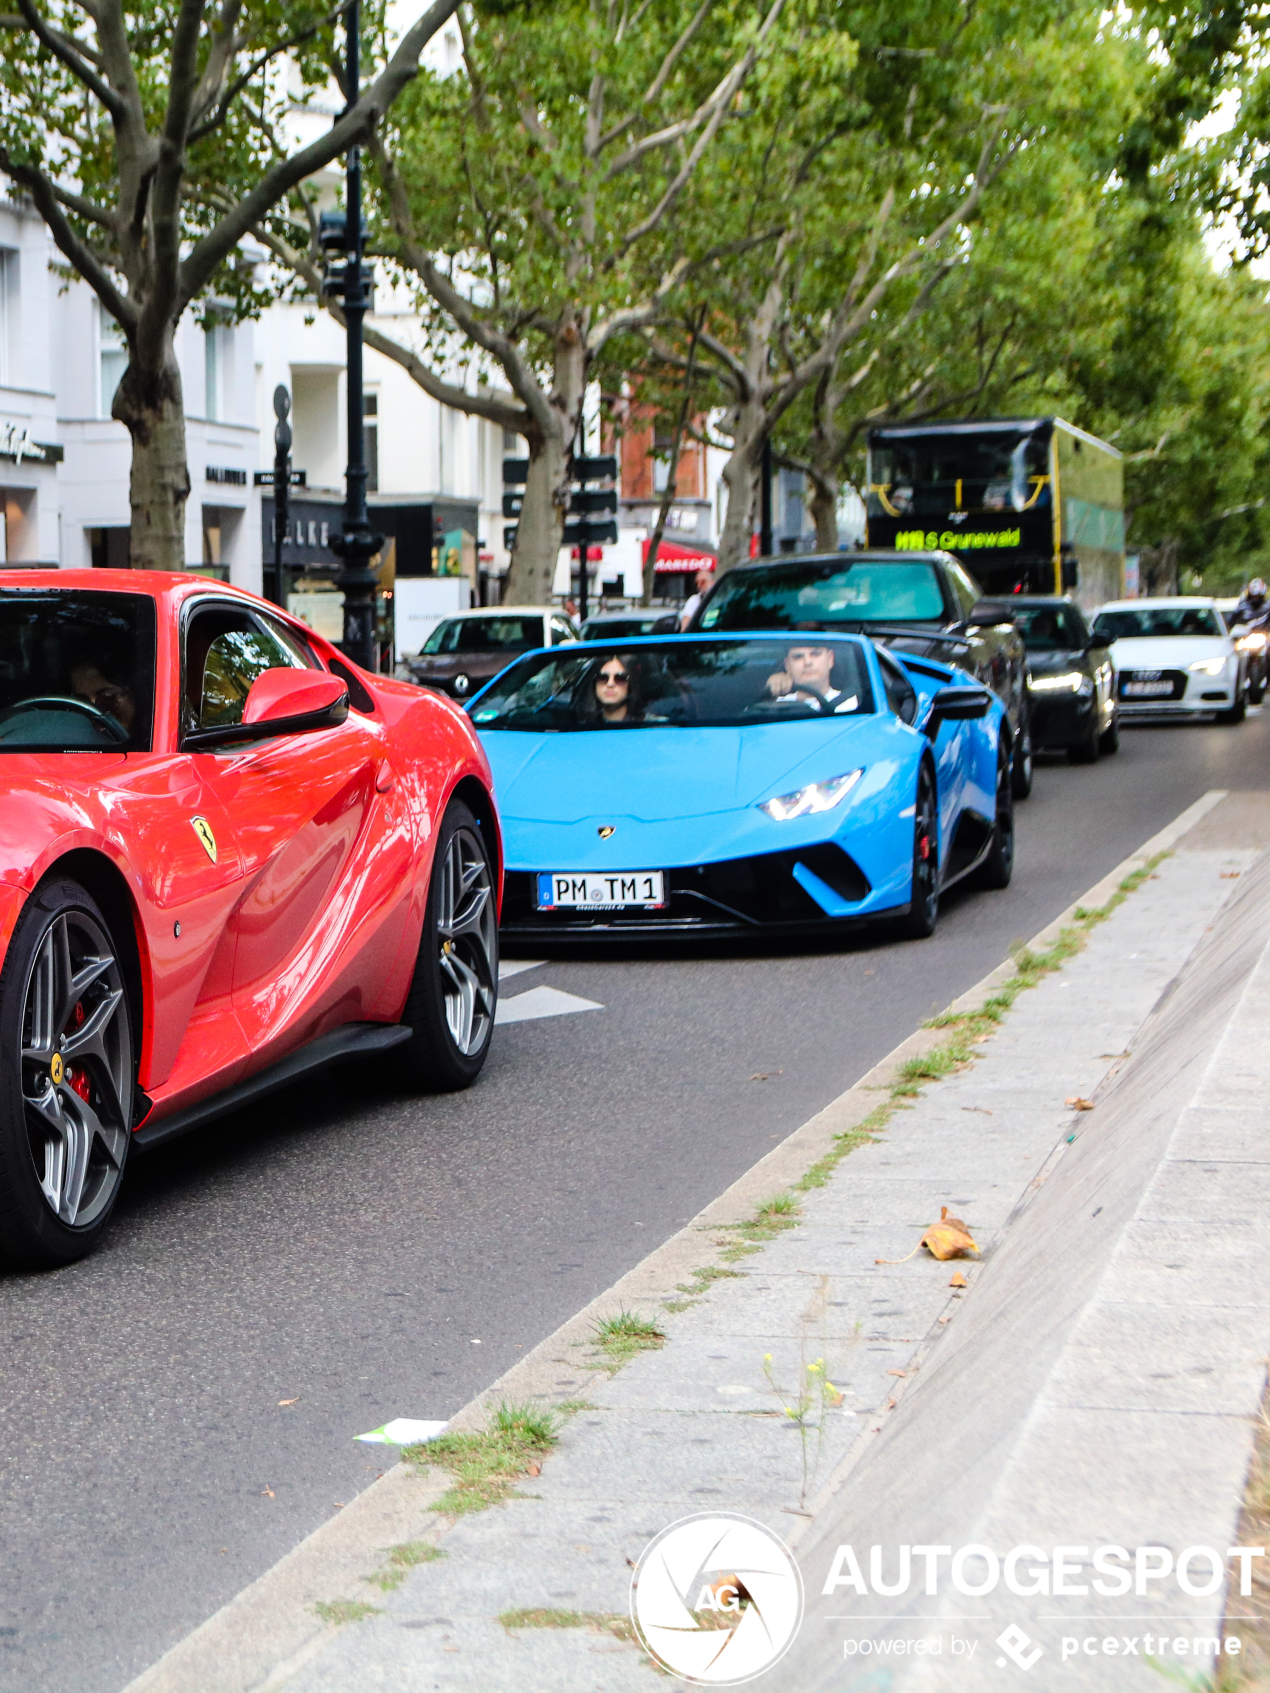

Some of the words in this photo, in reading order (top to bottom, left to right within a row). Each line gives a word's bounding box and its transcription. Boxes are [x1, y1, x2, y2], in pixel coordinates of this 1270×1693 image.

[939, 526, 1021, 550] Grunewald
[556, 878, 587, 901] PM
[605, 877, 637, 900] TM
[643, 877, 658, 899] 1
